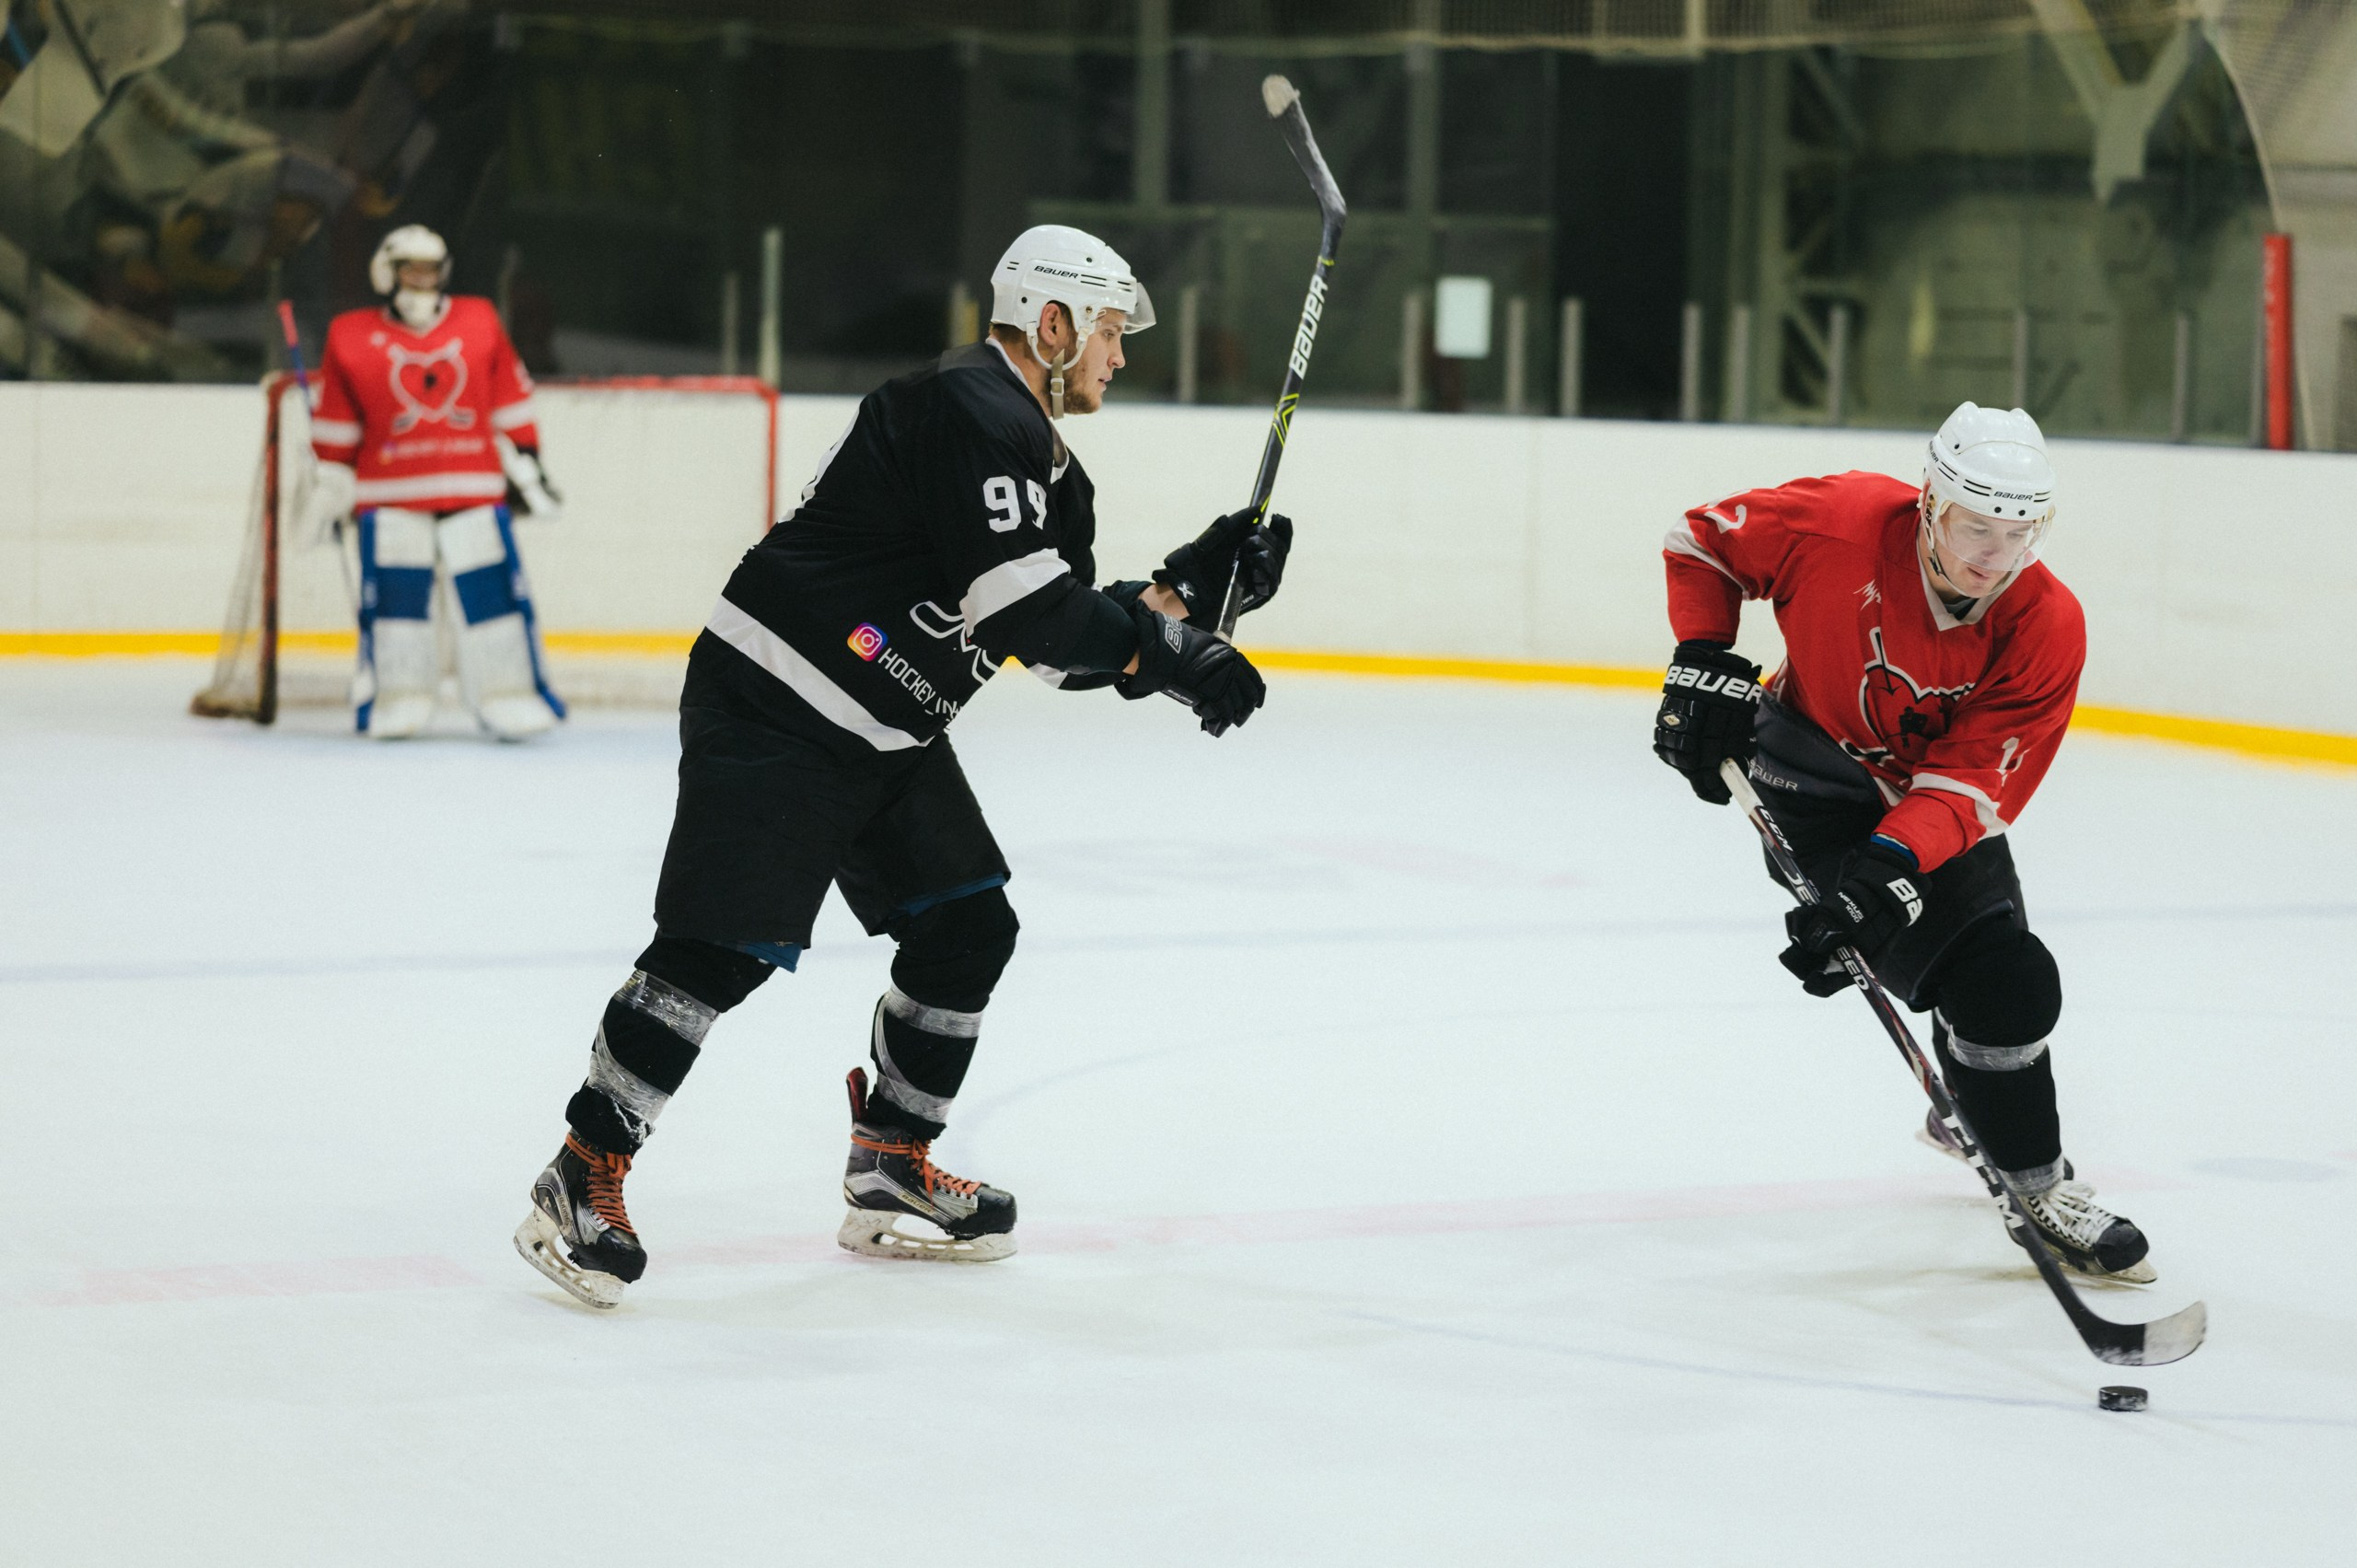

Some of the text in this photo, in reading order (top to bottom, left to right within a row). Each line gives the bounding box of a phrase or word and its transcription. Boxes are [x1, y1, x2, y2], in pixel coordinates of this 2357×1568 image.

[1034, 265, 1079, 279] BAUER
[1289, 274, 1329, 380] BAUER
[982, 475, 1048, 533] 99
[1993, 491, 2034, 502] BAUER
[1665, 665, 1762, 704] BAUER
[1837, 891, 1864, 920] NEXUS
[1845, 904, 1861, 923] 1000
